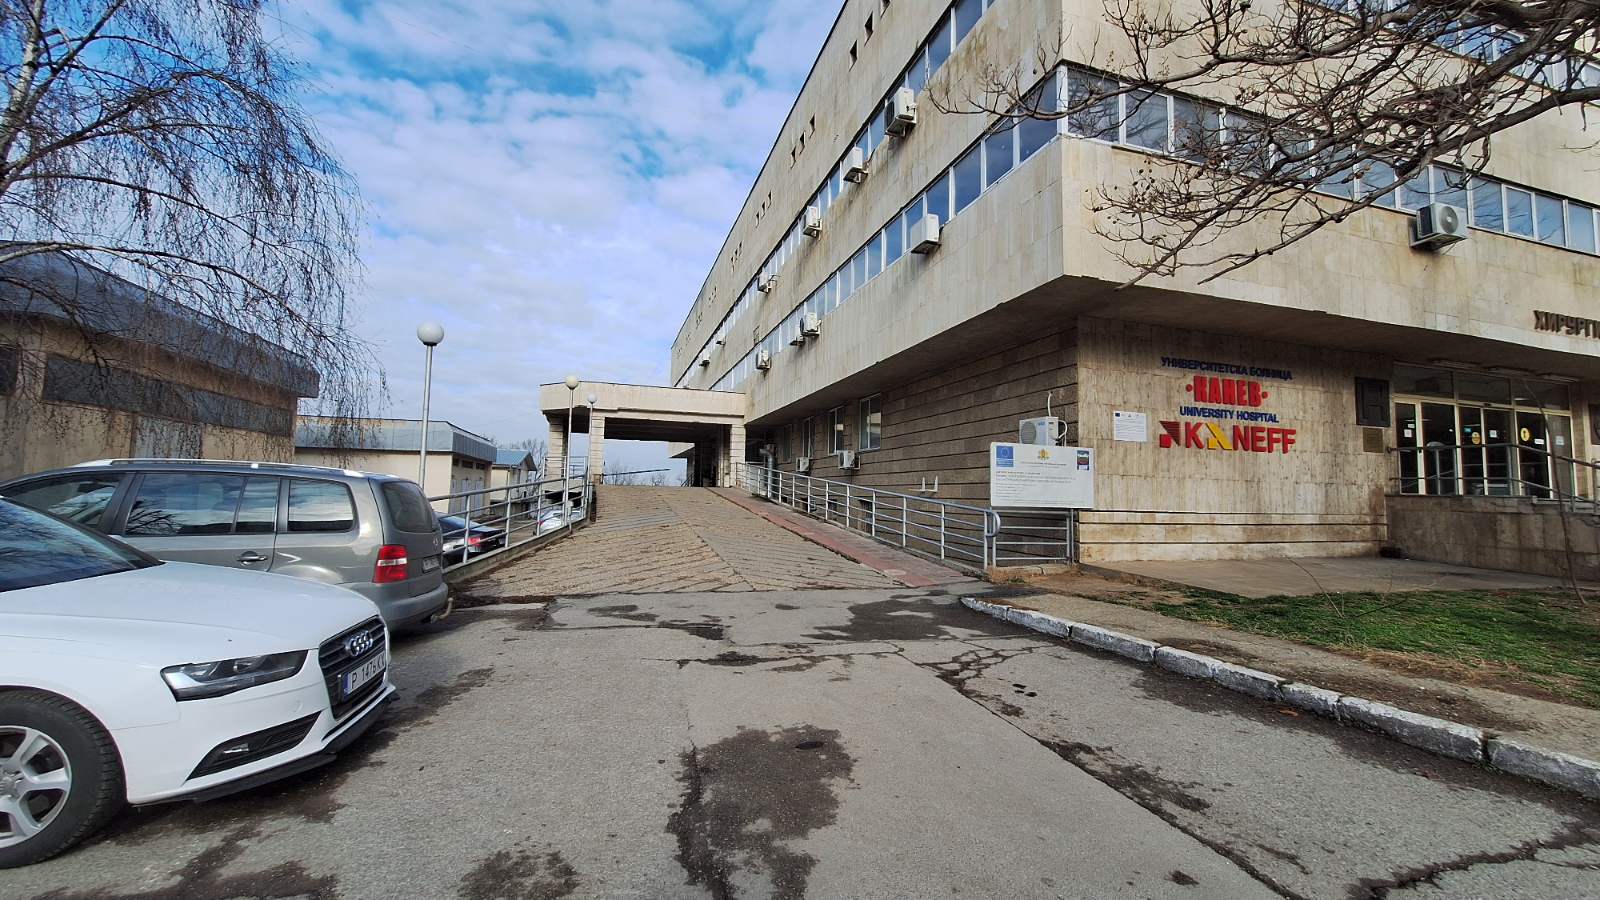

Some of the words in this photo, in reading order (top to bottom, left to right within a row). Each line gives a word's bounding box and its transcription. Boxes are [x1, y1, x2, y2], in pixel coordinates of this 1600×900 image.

[1161, 356, 1248, 376] УНИВЕРСИТЕТСКА
[1250, 367, 1293, 381] БОЛНИЦА
[1179, 406, 1234, 419] UNIVERSITY
[1236, 411, 1279, 423] HOSPITAL
[1184, 421, 1297, 454] KANEFF
